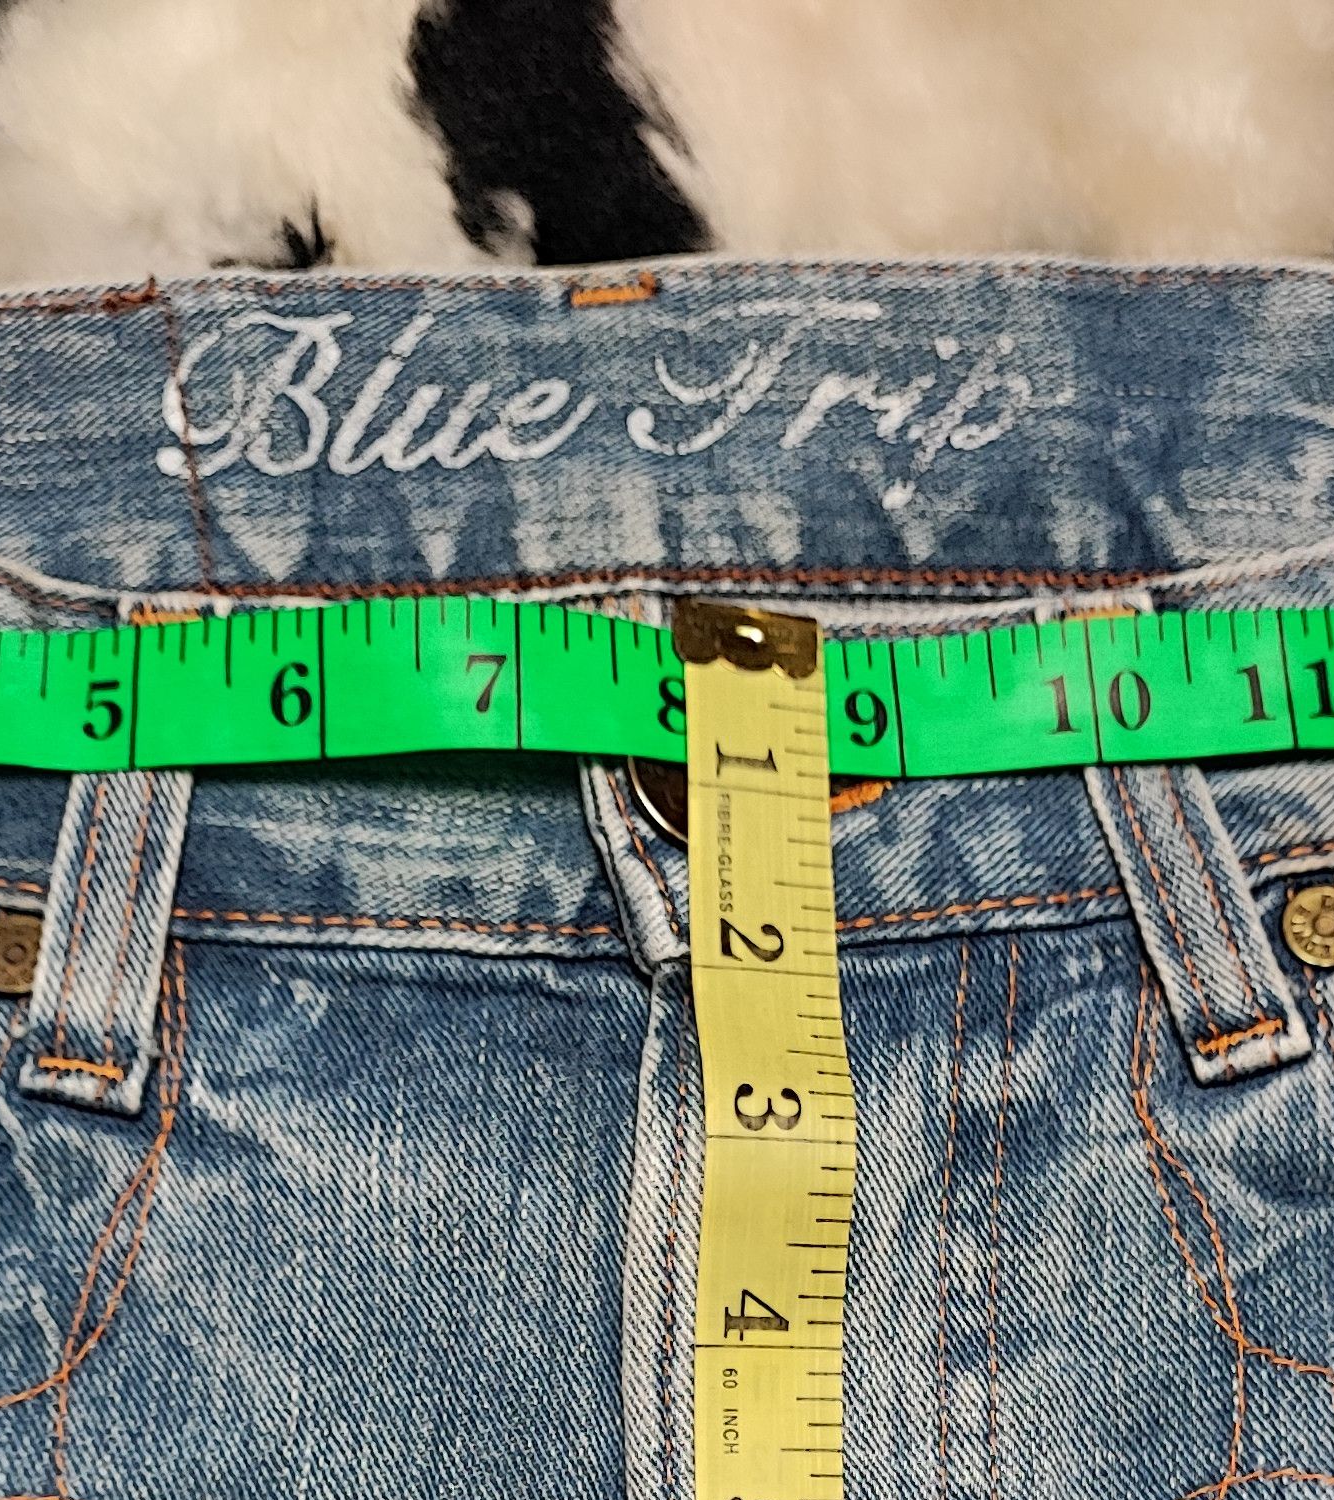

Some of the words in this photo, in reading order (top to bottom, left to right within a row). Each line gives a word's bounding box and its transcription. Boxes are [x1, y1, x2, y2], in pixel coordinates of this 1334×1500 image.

[155, 308, 593, 479] Blue
[627, 301, 1069, 510] Trip
[81, 681, 123, 740] 5
[271, 664, 313, 726] 6
[467, 654, 508, 714] 7
[657, 677, 686, 735] 8
[845, 690, 888, 746] 9
[716, 742, 778, 776] 1
[718, 793, 734, 913] FIBRE-GLASS
[720, 917, 784, 962] 2
[735, 1083, 801, 1131] 3
[724, 1289, 790, 1341] 4
[723, 1367, 738, 1390] 60
[723, 1408, 739, 1455] INCH
